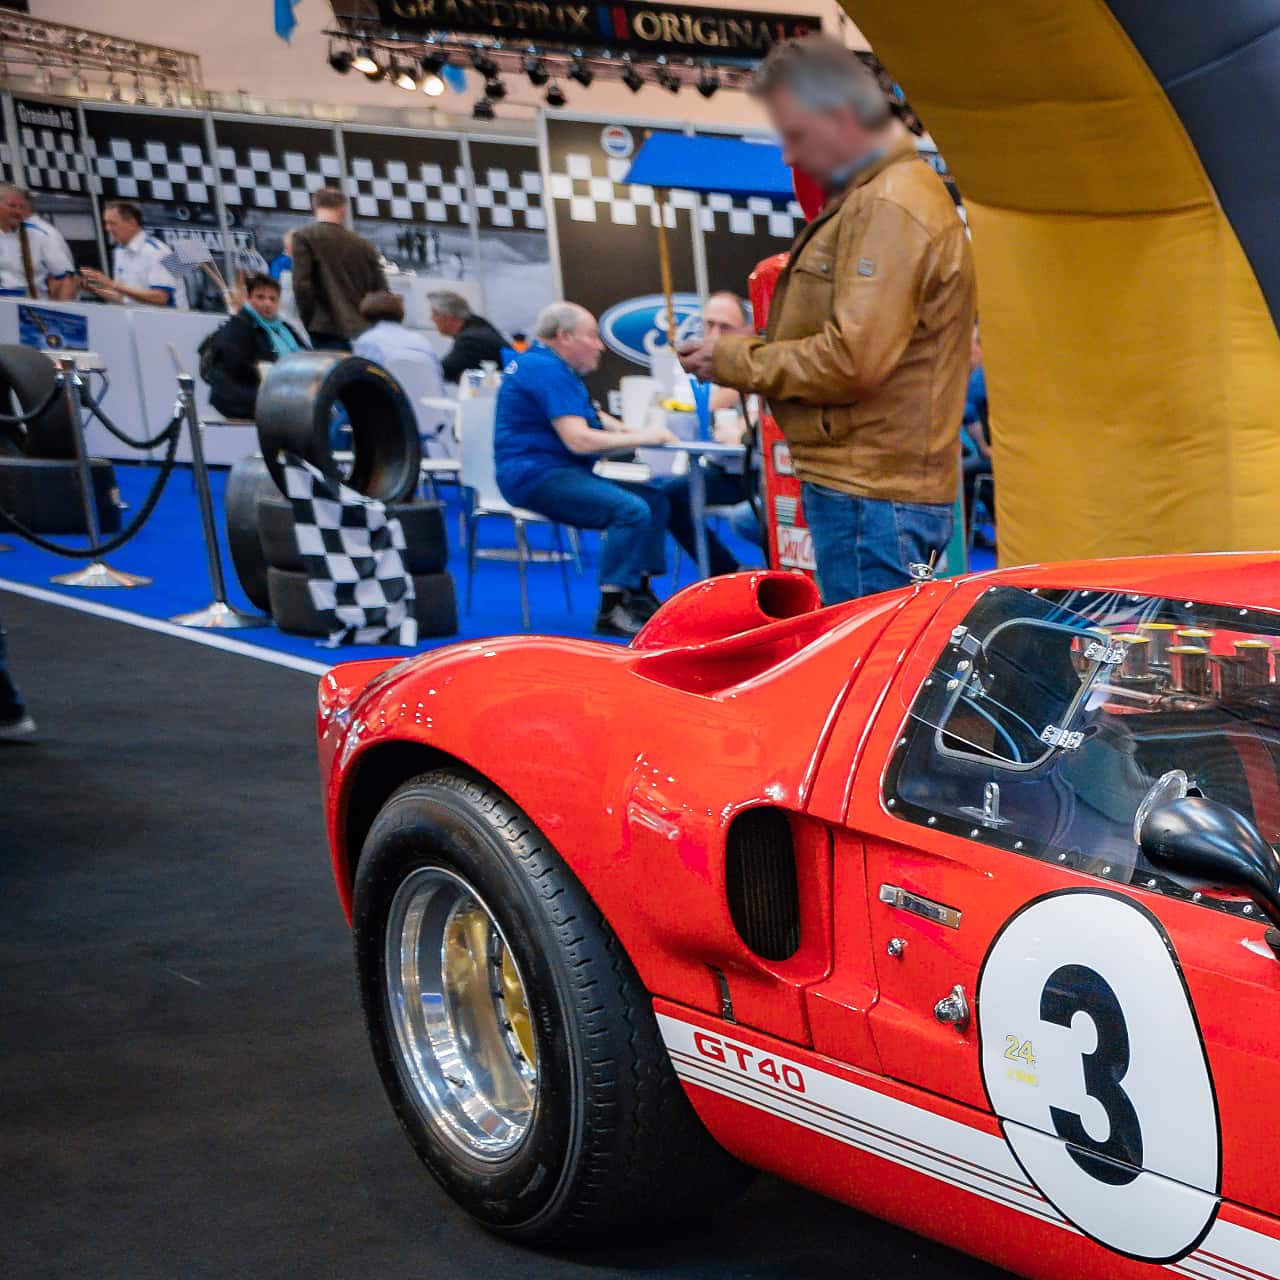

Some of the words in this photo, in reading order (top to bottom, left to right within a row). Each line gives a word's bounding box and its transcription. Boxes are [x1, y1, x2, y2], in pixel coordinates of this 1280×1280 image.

[693, 1031, 806, 1093] GT40
[1004, 1034, 1037, 1064] 24
[1040, 964, 1143, 1186] 3
